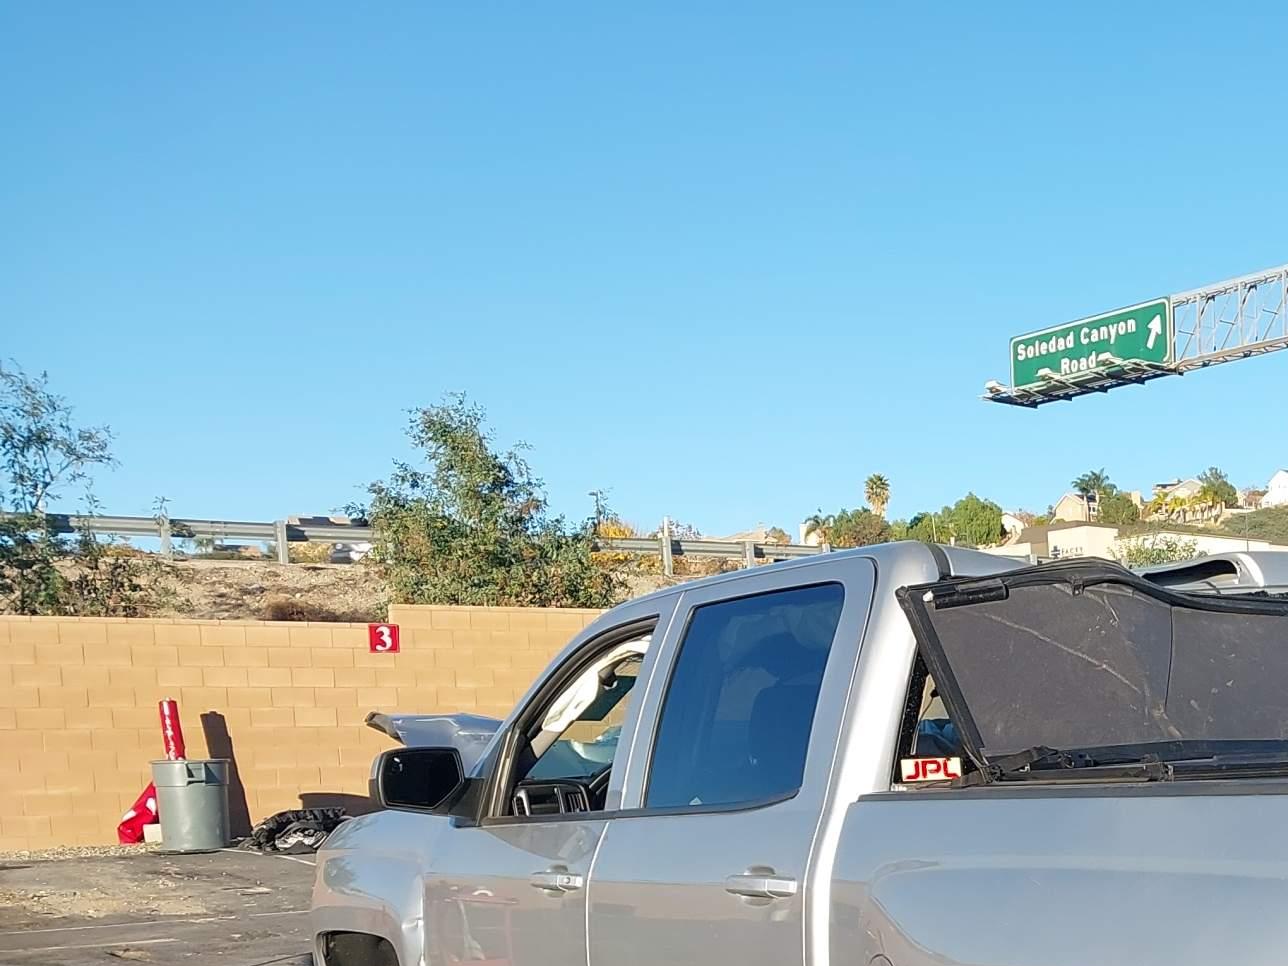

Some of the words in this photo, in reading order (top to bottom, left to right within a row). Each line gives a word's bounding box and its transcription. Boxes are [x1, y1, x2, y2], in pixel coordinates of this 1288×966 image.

[1017, 331, 1074, 361] Soledad
[1080, 318, 1136, 345] Canyon
[1060, 351, 1097, 376] Road
[375, 625, 393, 651] 3
